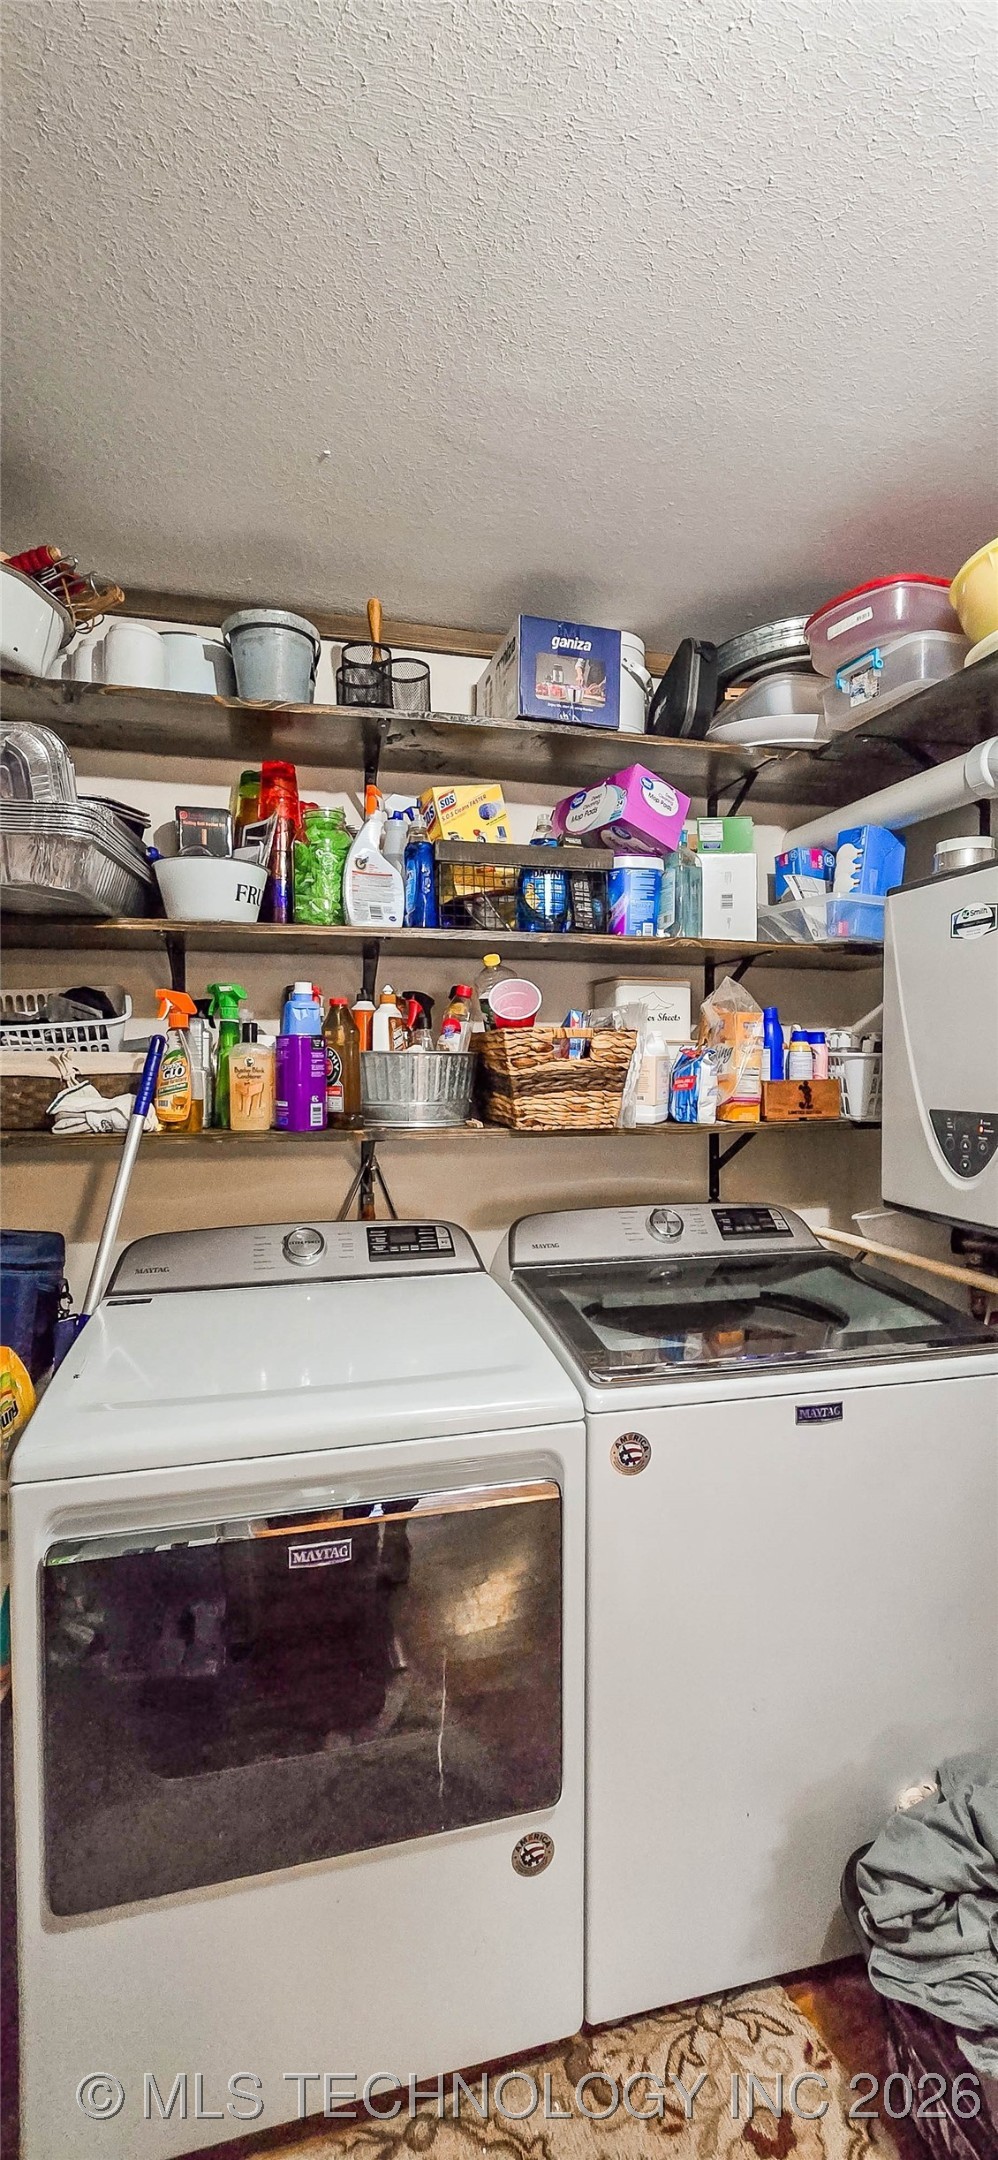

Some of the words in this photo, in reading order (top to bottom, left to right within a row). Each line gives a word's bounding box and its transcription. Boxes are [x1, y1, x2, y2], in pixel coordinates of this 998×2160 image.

[551, 636, 592, 652] ganiza
[440, 794, 455, 808] SOS
[469, 793, 487, 807] FASTER
[657, 1012, 681, 1022] Sheets
[163, 1065, 185, 1080] GLO
[532, 1242, 560, 1250] MAYTAG
[134, 1266, 170, 1275] MAYTAG
[798, 1405, 841, 1420] MAYTAG
[614, 1434, 649, 1453] AMERICA
[292, 1545, 349, 1564] MAYTAG
[514, 1833, 551, 1853] AMERICA
